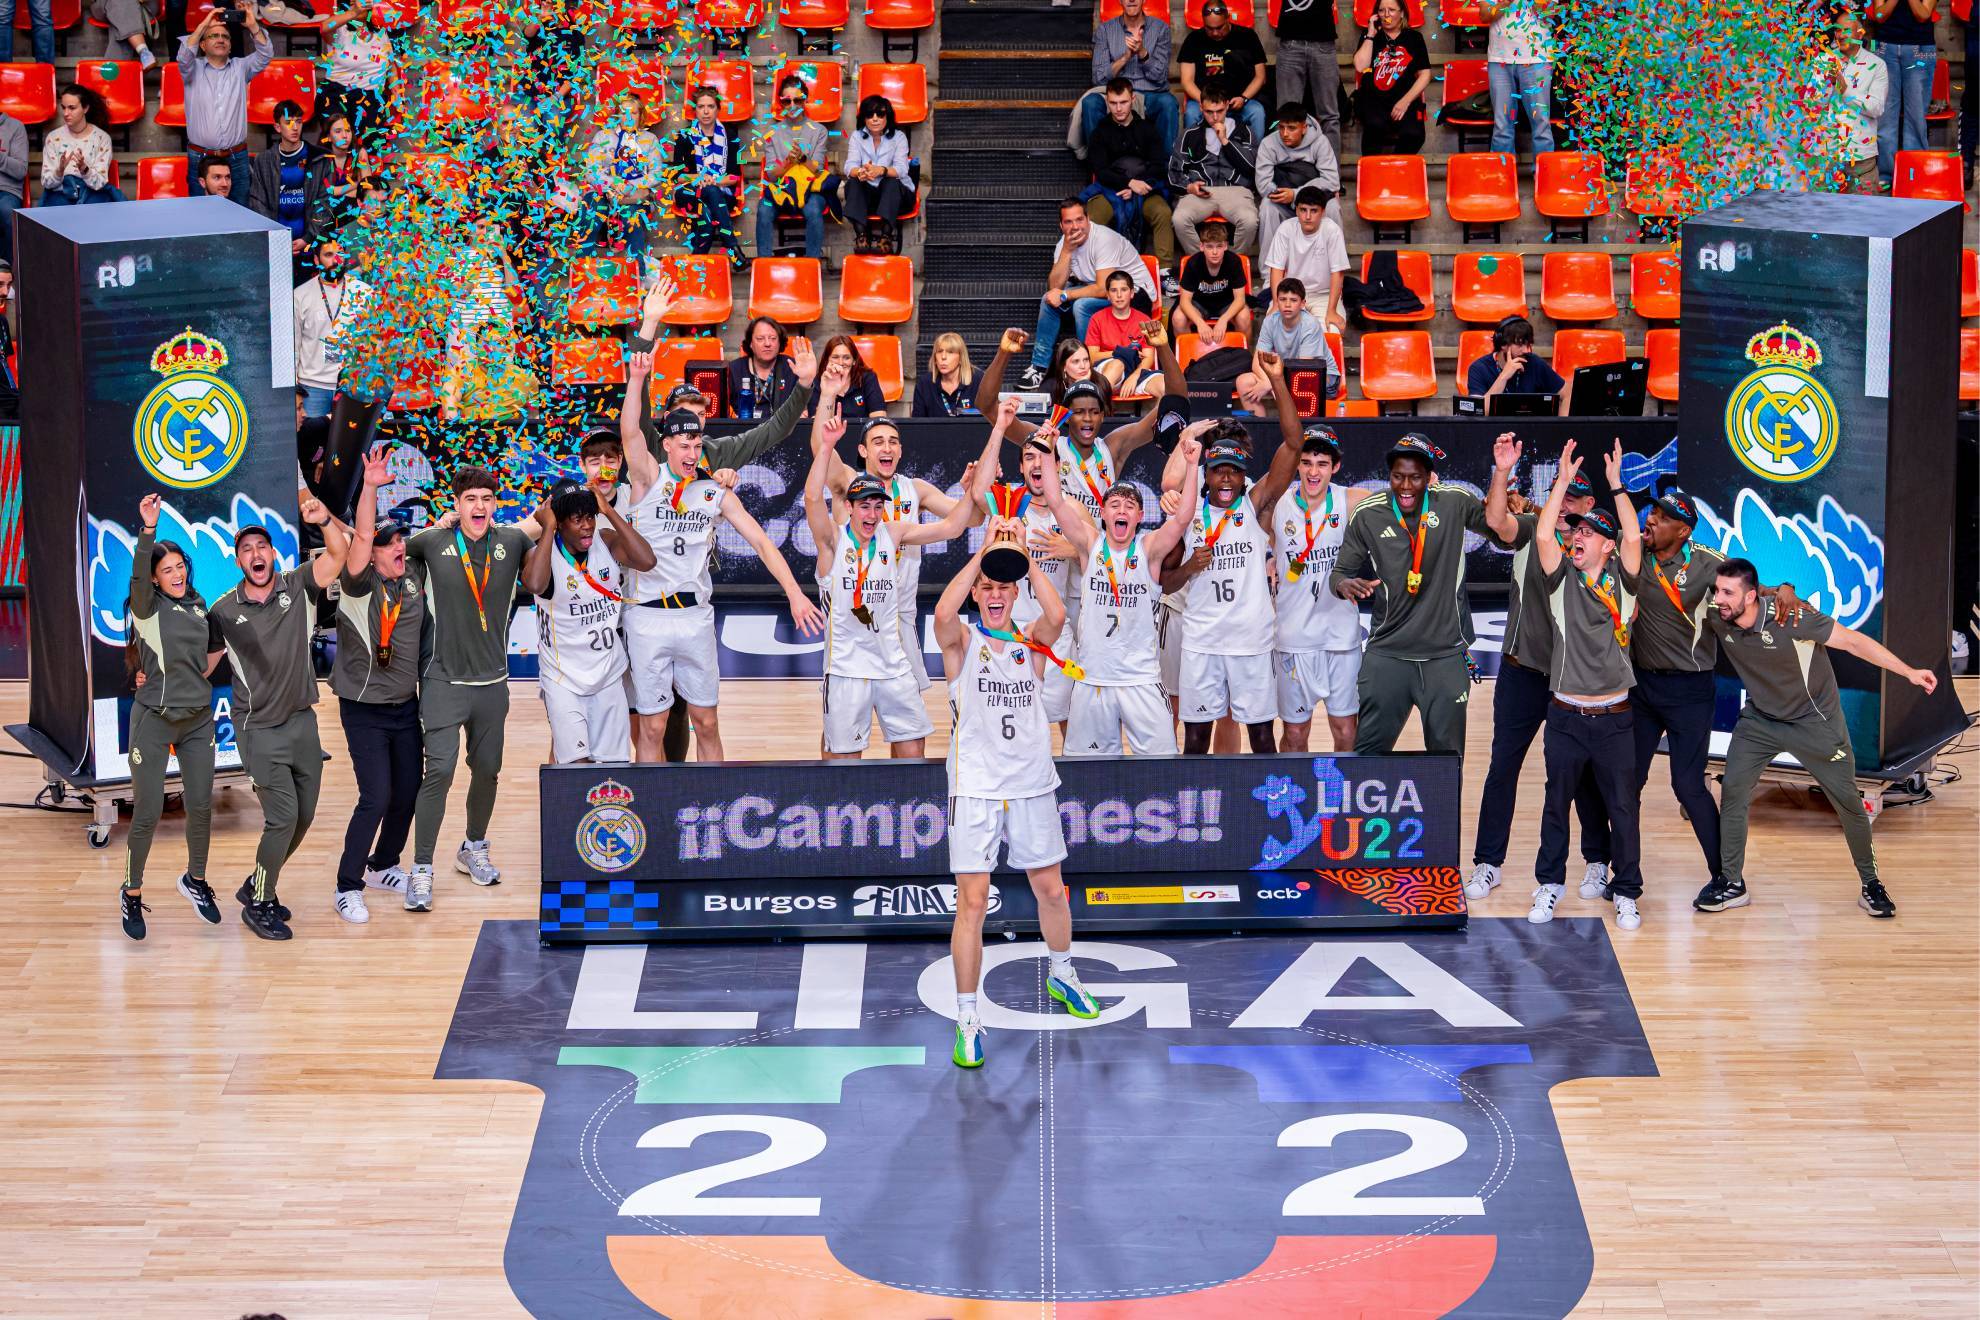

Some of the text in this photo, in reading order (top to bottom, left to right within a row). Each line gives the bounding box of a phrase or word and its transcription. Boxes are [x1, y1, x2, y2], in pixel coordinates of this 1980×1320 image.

[1293, 371, 1317, 417] 5
[677, 521, 705, 533] BETTER
[673, 536, 686, 556] 8
[1193, 541, 1253, 557] irates
[1217, 556, 1246, 570] BETTER
[1090, 576, 1147, 595] Emrates
[1211, 579, 1235, 603] 16
[1096, 594, 1108, 605] FLY
[597, 603, 618, 622] BEER
[1106, 613, 1119, 637] 7
[588, 627, 615, 651] 20
[987, 694, 1032, 708] FLY BETTER
[1001, 713, 1016, 741] 6
[1317, 779, 1424, 814] LIGA
[676, 789, 1224, 859] ¡¡Campnes!!
[1320, 817, 1425, 860] U22
[1257, 887, 1302, 900] acb
[703, 894, 828, 915] Burgos
[566, 941, 1523, 1031] LIGA
